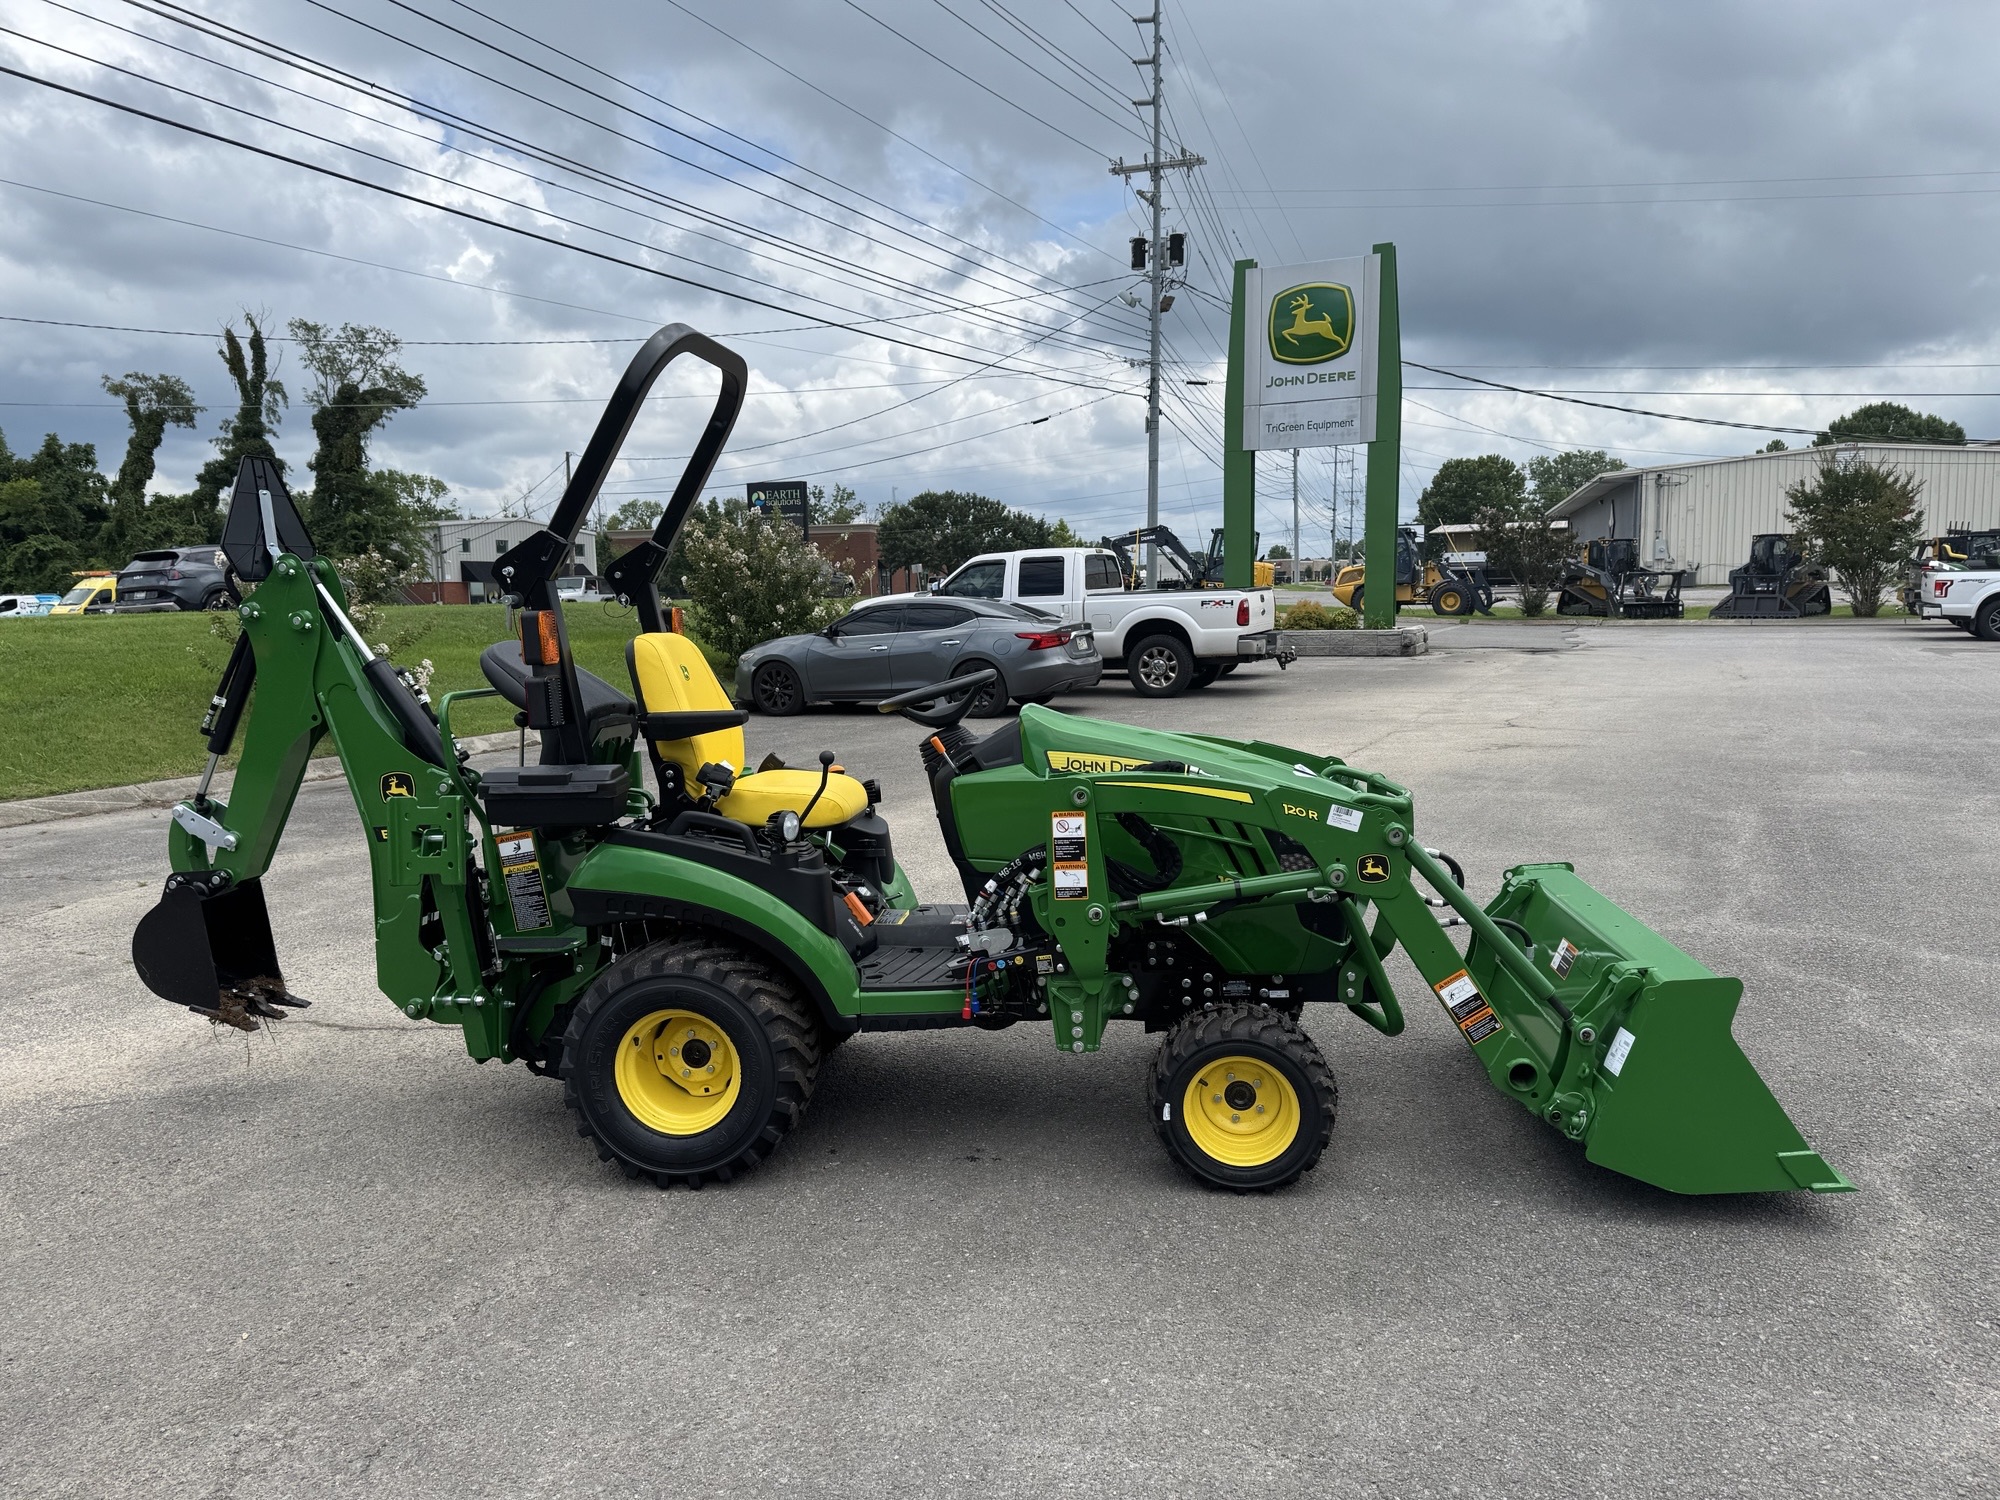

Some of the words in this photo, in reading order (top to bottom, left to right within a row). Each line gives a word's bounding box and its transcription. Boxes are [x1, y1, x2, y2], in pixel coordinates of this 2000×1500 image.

[1266, 375, 1304, 388] JOHN
[1307, 371, 1356, 384] DEERE
[1266, 422, 1304, 433] TriGreen
[1307, 419, 1354, 432] Equipment
[766, 489, 800, 499] EARTH
[1200, 599, 1234, 607] FX4
[1060, 757, 1106, 772] JOHN
[1282, 803, 1307, 817] 120
[1308, 809, 1319, 821] R
[512, 864, 536, 873] CAUTION
